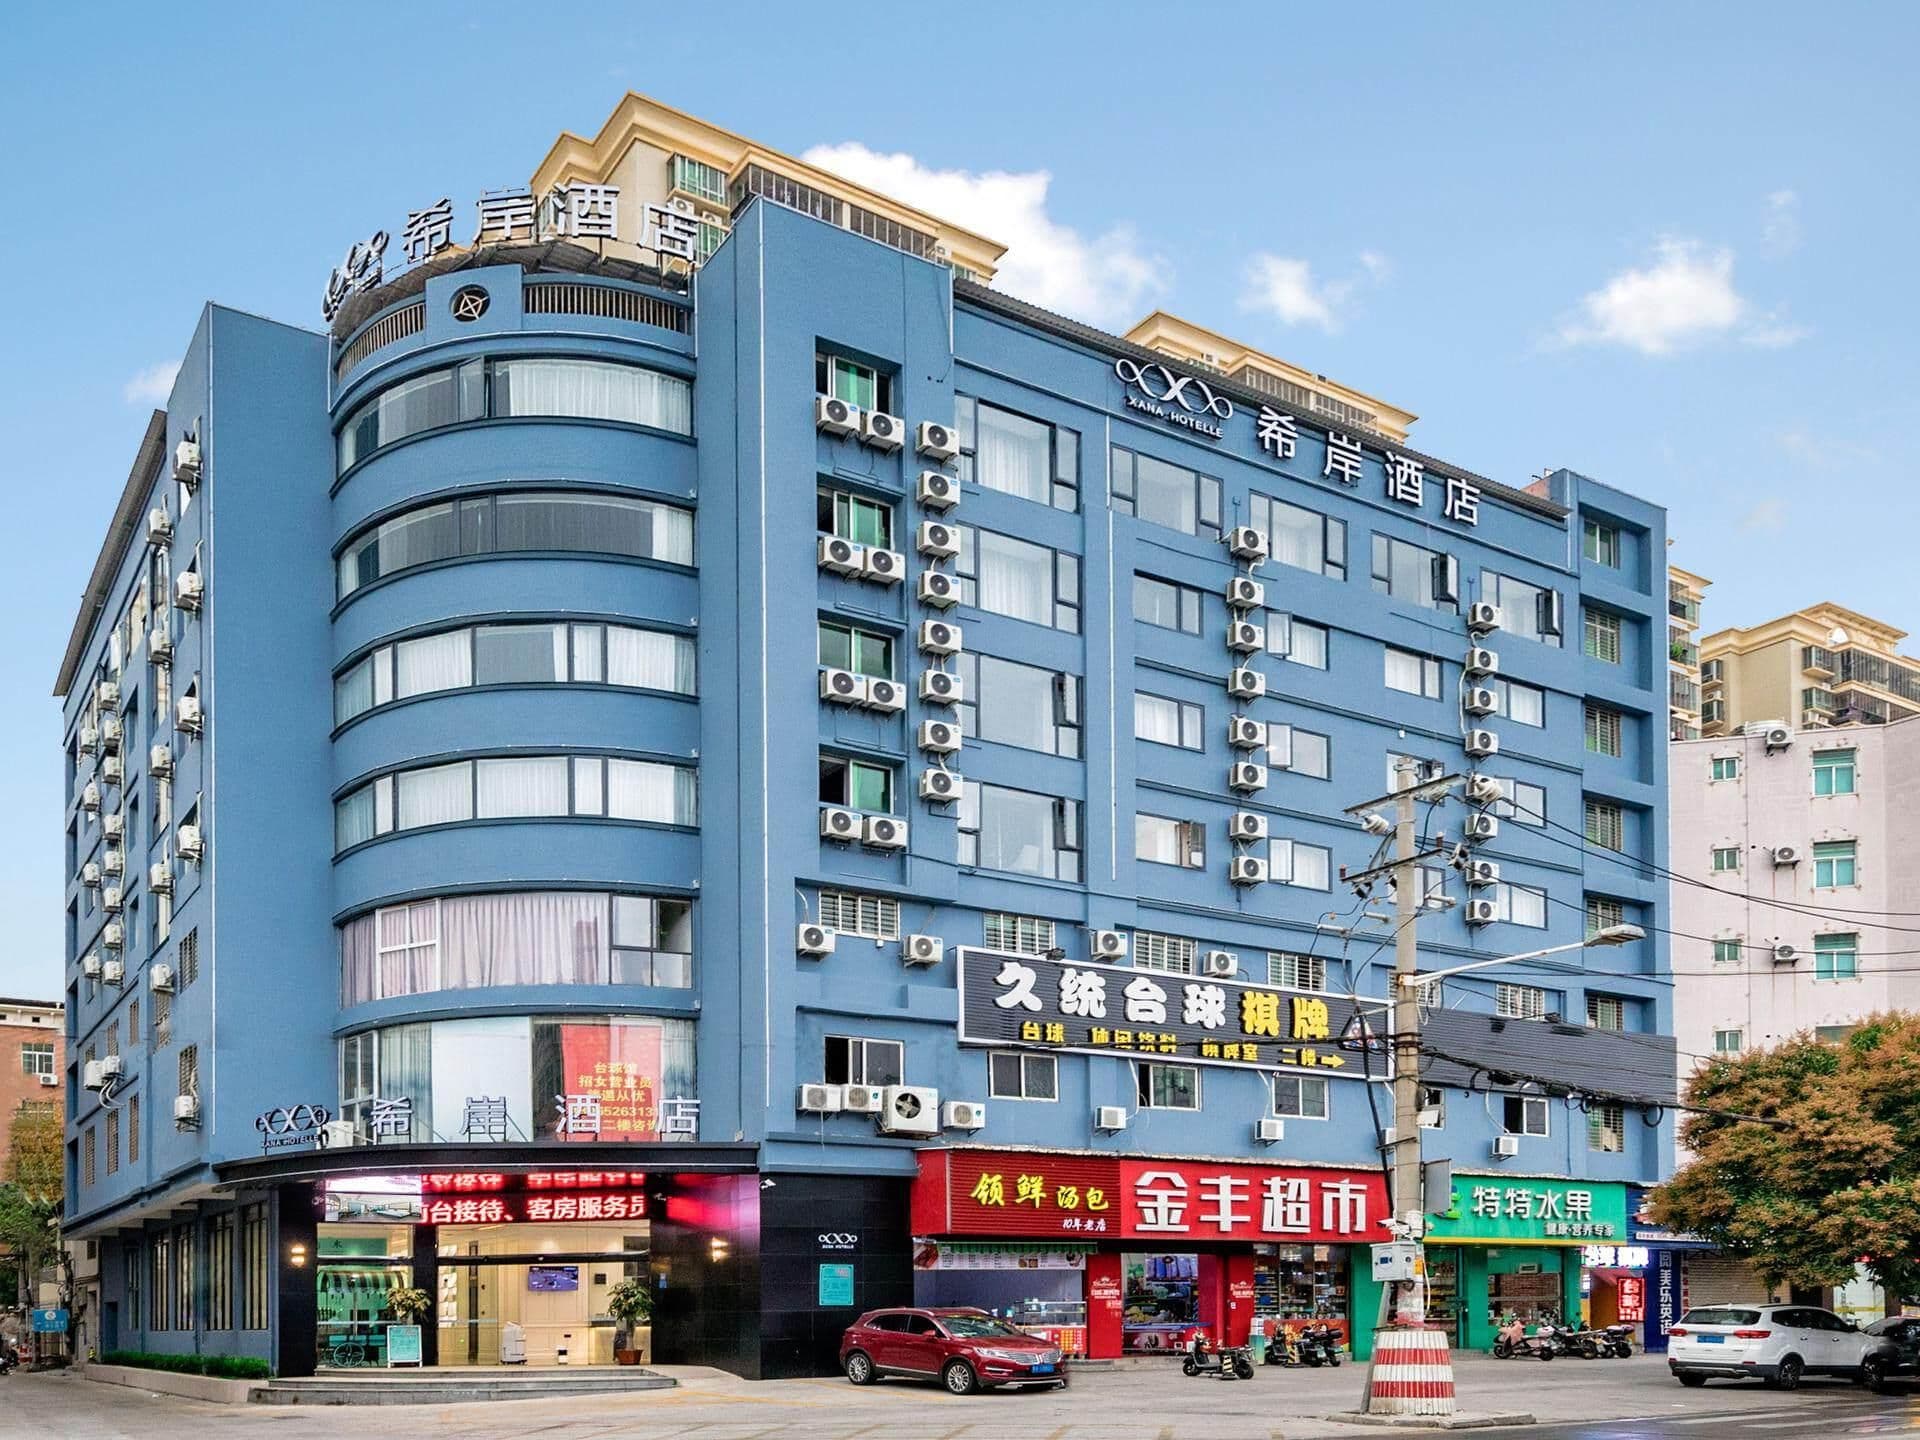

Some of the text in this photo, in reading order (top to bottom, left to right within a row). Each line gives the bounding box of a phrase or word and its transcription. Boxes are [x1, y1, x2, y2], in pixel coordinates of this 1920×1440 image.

[1129, 395, 1224, 438] XANA HOTELLE
[1257, 405, 1481, 526] 希岸酒店
[995, 962, 1330, 1040] 久统台球棋牌
[1021, 1021, 1064, 1043] 台球
[370, 1095, 701, 1134] 希岸酒店
[971, 1173, 1109, 1210] 领鲜汤包
[1134, 1171, 1367, 1233] 金丰超市
[1472, 1185, 1593, 1220] 特特水果
